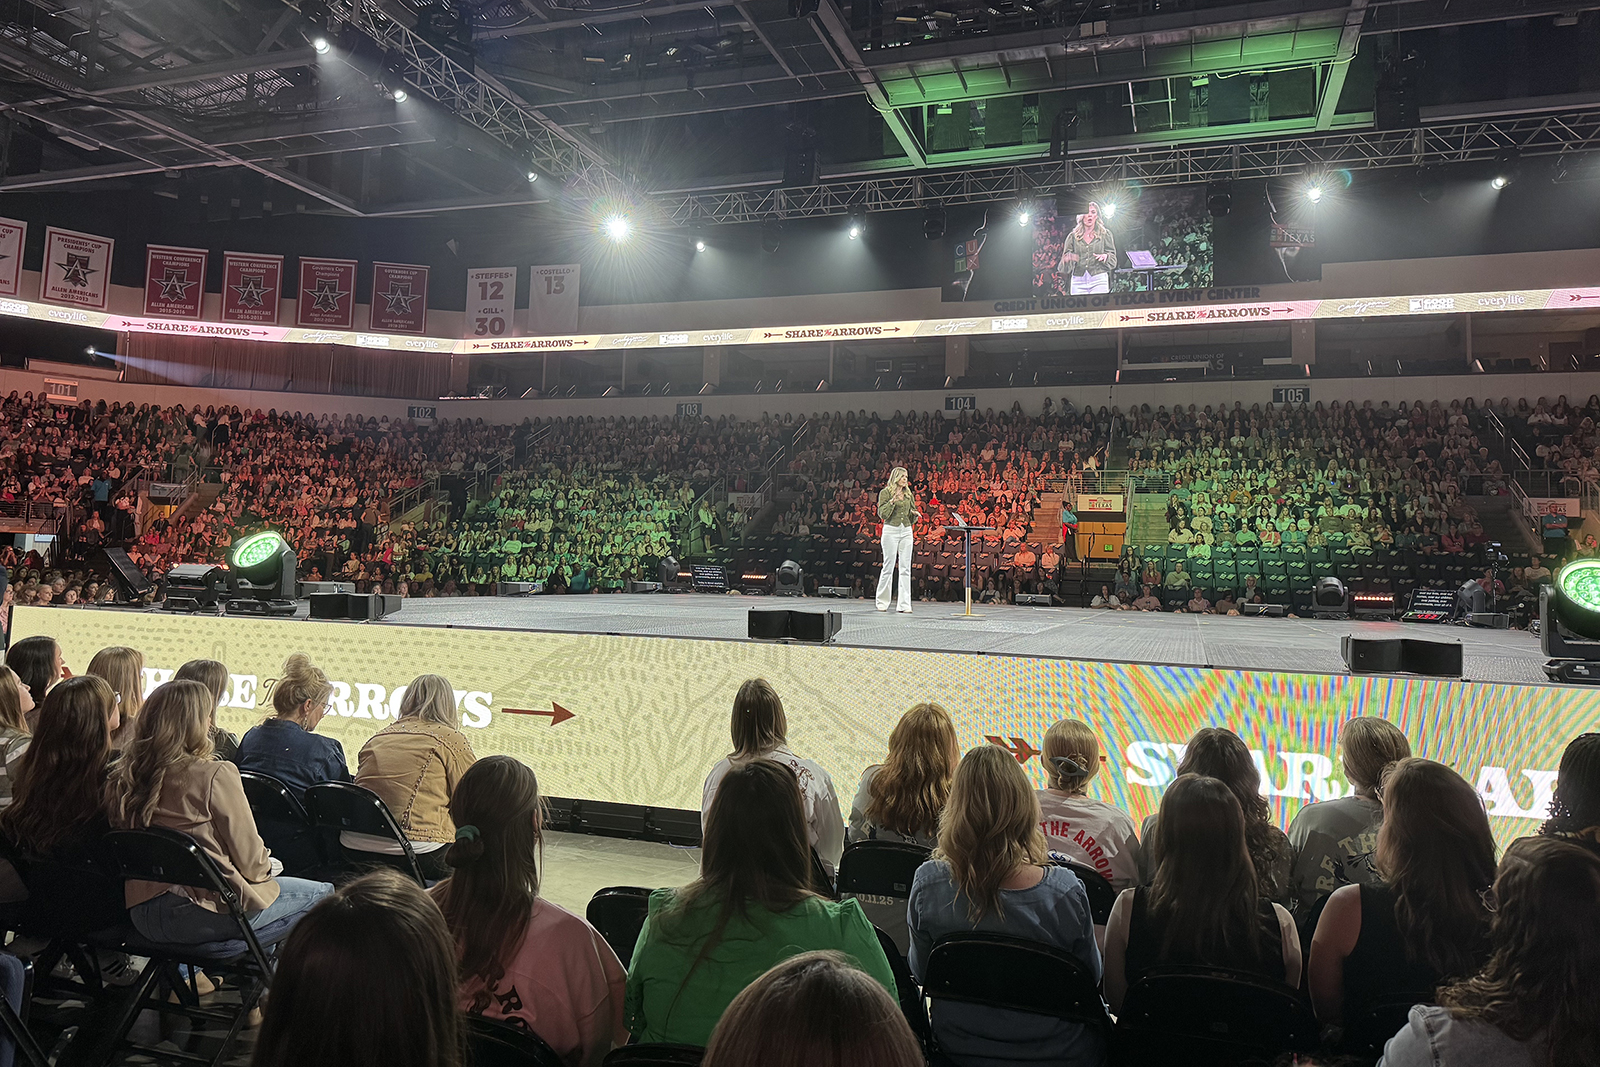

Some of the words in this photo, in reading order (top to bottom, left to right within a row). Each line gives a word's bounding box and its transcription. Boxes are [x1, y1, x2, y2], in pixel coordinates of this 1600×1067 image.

[1283, 233, 1315, 243] TEXAS
[63, 243, 95, 254] CHAMPIONS
[162, 260, 190, 268] CHAMPIONS
[315, 270, 340, 278] Champions
[475, 272, 509, 280] STEFFES
[539, 268, 571, 276] COSTELLO
[478, 281, 504, 301] 12
[544, 275, 565, 296] 13
[68, 288, 99, 299] AMERICANS
[994, 300, 1037, 312] CREDIT
[1041, 296, 1087, 310] UNION
[1091, 294, 1110, 306] OF
[1113, 290, 1156, 306] TEXAS
[1159, 289, 1203, 303] EVENT
[1207, 286, 1260, 300] CENTER
[1478, 295, 1525, 308] everylife
[48, 308, 88, 322] everylife
[482, 307, 500, 315] GILL
[1147, 311, 1196, 322] SHARE
[1206, 307, 1270, 319] ARROWS
[474, 317, 506, 337] 30
[1046, 316, 1085, 328] everylife
[146, 322, 189, 333] SHARE
[198, 325, 250, 336] ARROWS
[785, 329, 823, 339] SHARE
[831, 326, 882, 337] ARROWS
[405, 339, 438, 350] everylife
[491, 341, 523, 349] SHARE
[530, 339, 573, 348] ARROWS
[702, 333, 733, 343] everylife
[50, 383, 71, 396] 101
[1279, 388, 1304, 403] 105
[681, 403, 698, 416] 103
[951, 397, 971, 410] 104
[413, 407, 432, 418] 102
[1039, 820, 1071, 838] THE
